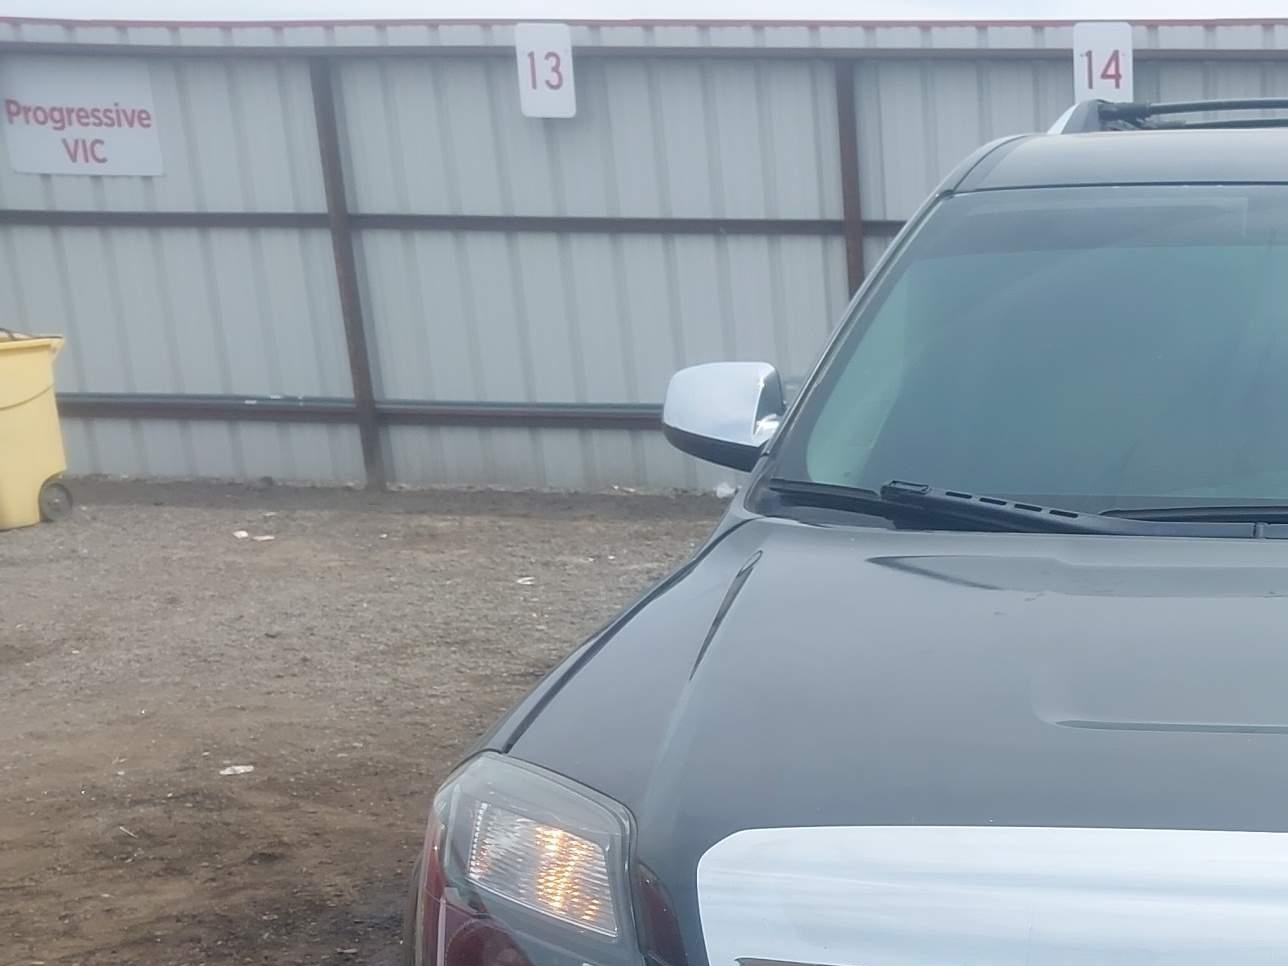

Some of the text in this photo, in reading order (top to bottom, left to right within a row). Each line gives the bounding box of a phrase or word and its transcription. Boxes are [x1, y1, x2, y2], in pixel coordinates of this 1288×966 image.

[528, 51, 563, 91] 13
[1085, 49, 1122, 90] 14
[5, 98, 152, 131] Progressive
[62, 138, 108, 164] VIC
